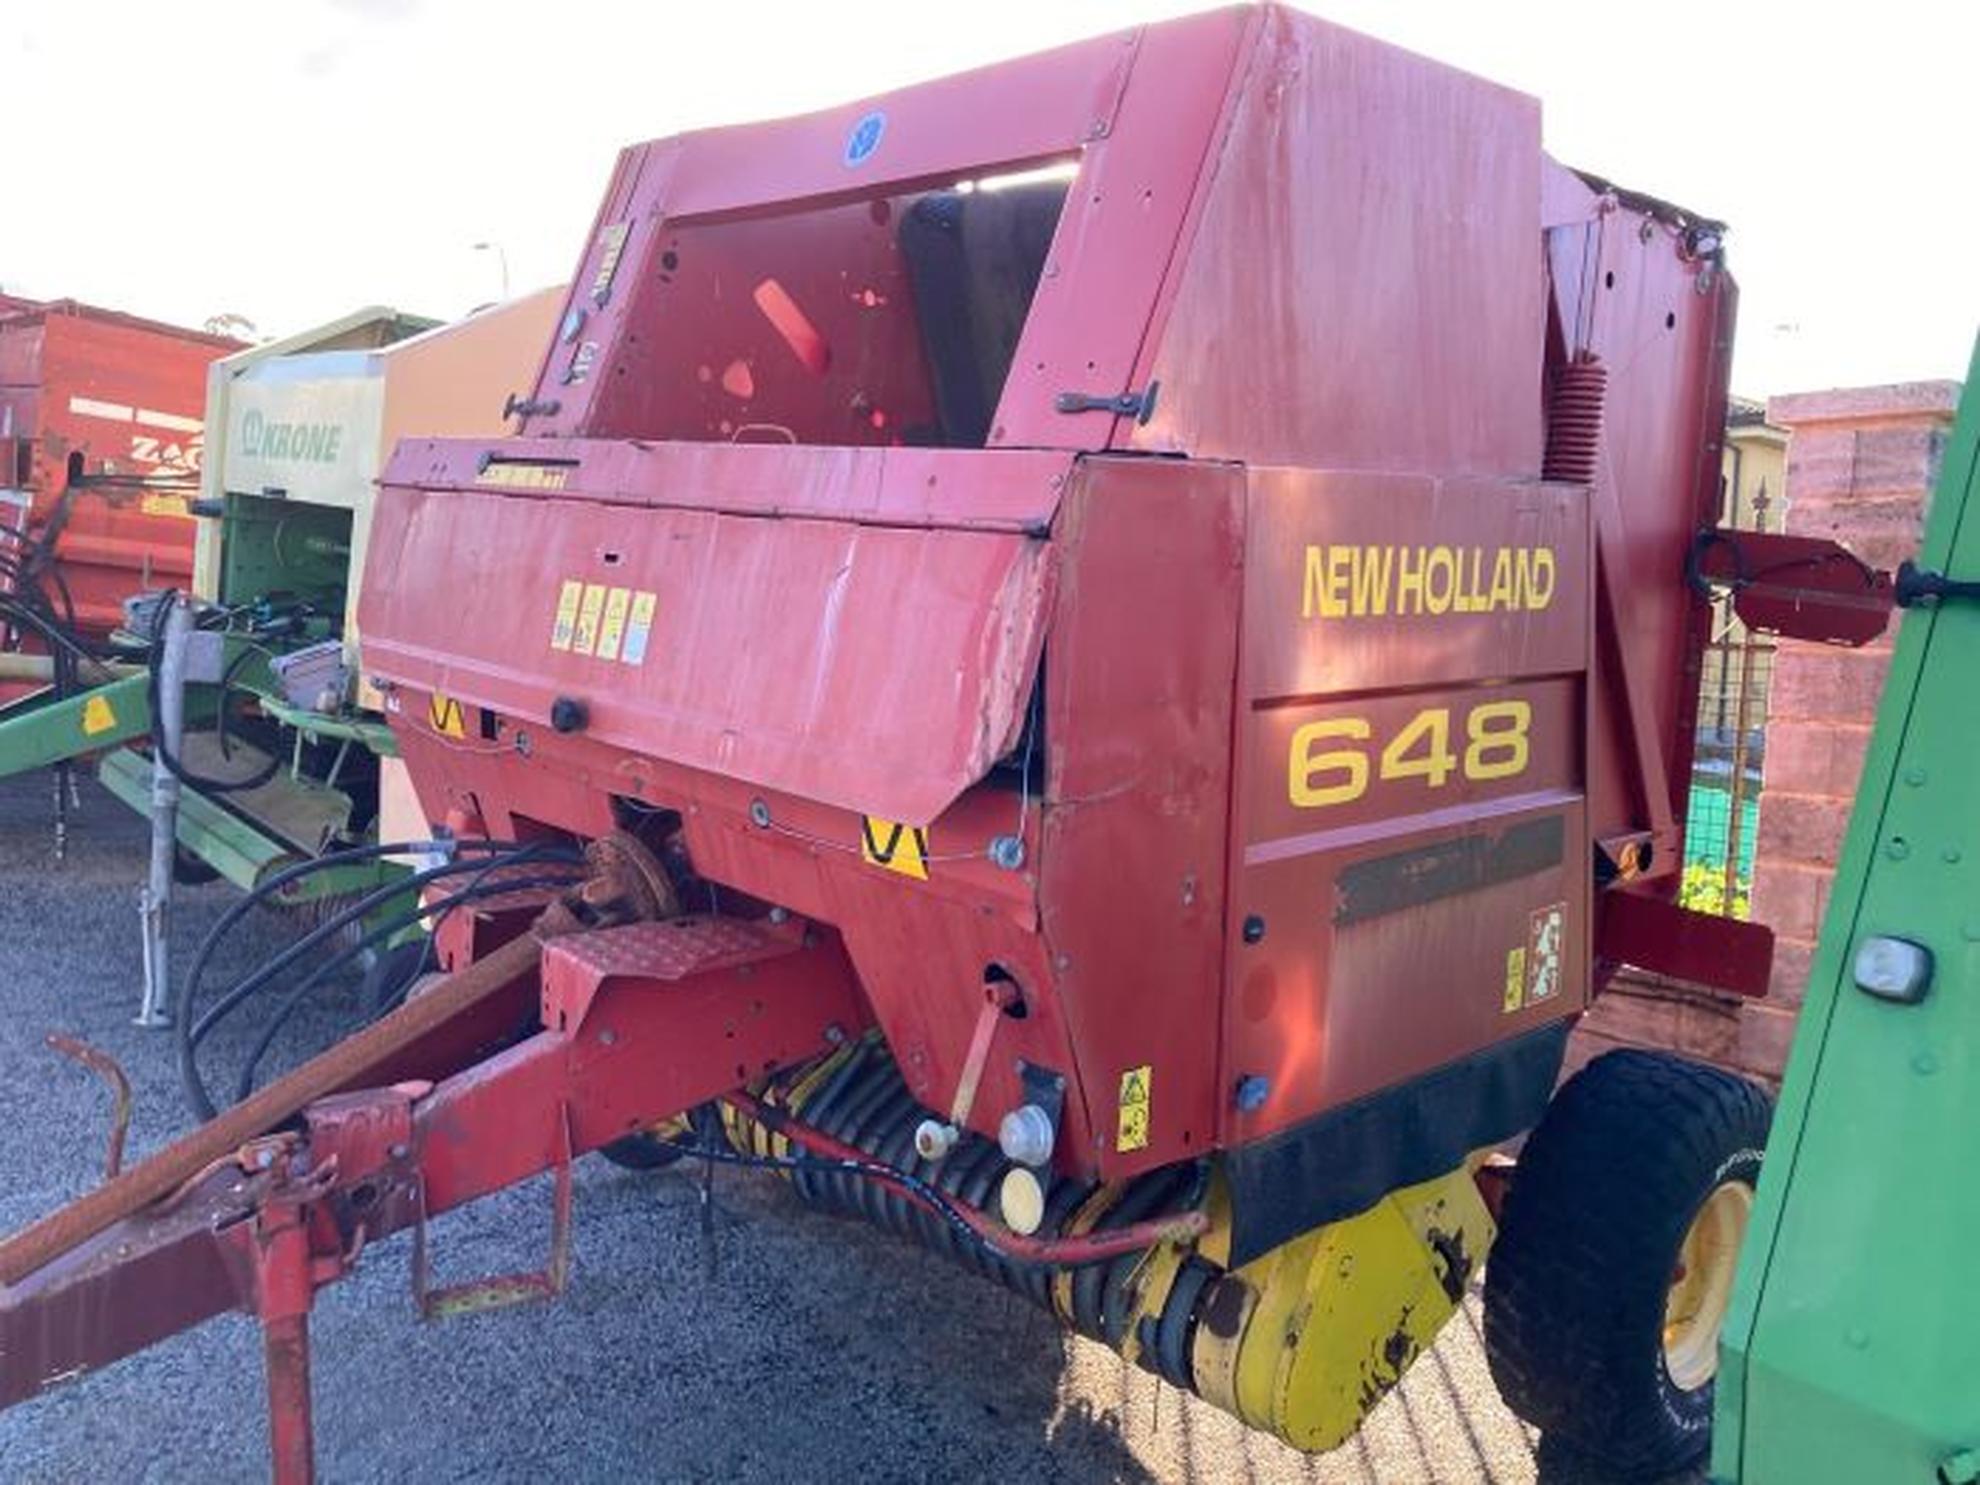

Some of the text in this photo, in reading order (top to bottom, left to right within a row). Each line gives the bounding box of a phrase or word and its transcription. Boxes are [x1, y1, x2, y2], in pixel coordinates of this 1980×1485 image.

[262, 421, 343, 462] KRONE
[1302, 545, 1555, 618] NEW HOLLAND
[1289, 700, 1532, 808] 648
